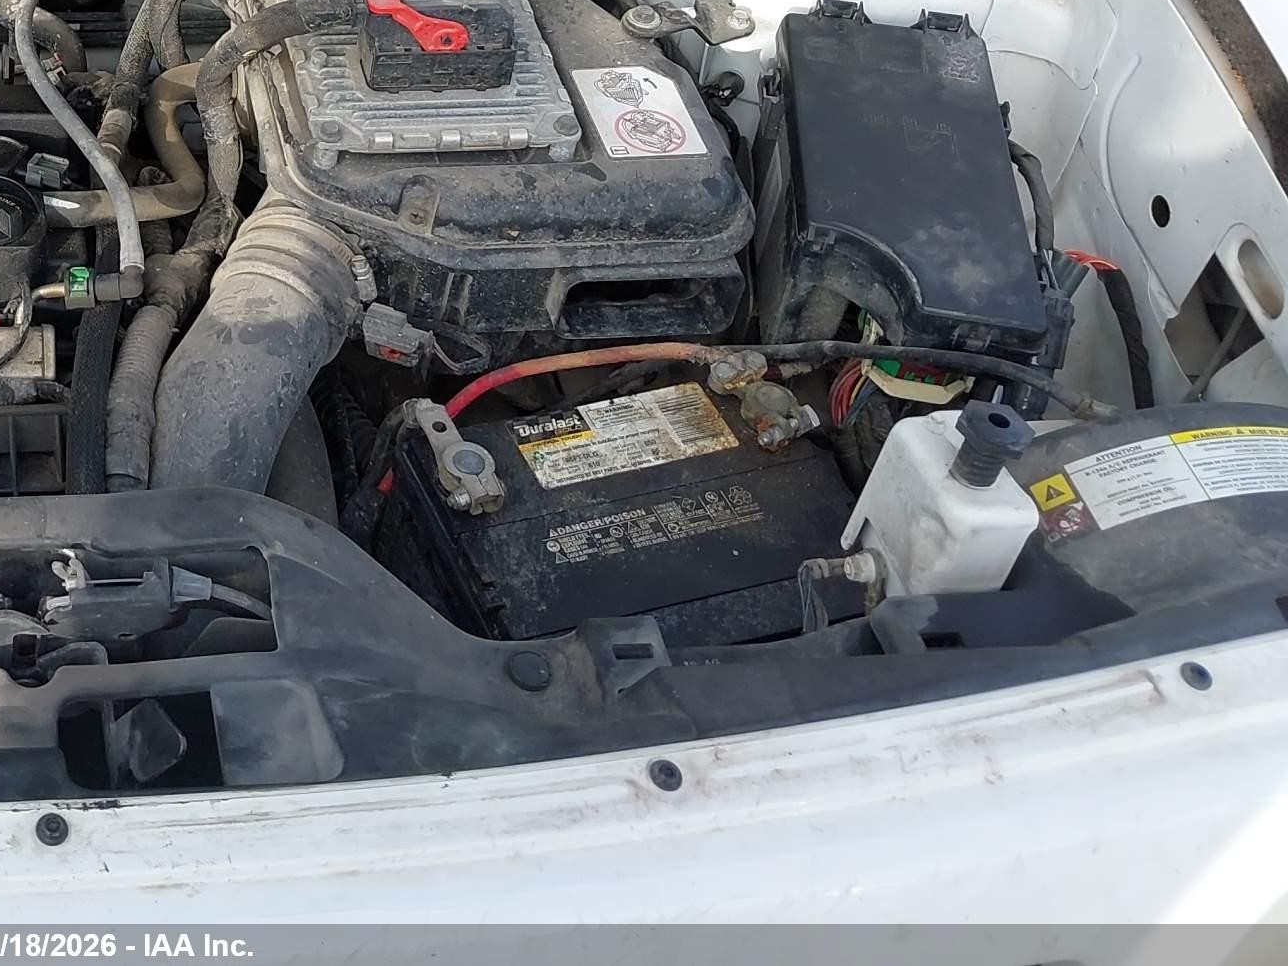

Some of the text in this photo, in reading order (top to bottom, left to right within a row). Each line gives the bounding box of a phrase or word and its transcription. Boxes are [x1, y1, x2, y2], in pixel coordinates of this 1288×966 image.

[513, 414, 581, 437] Duralast
[1096, 444, 1143, 463] ATTENTION
[557, 508, 646, 536] DANGER/POISON
